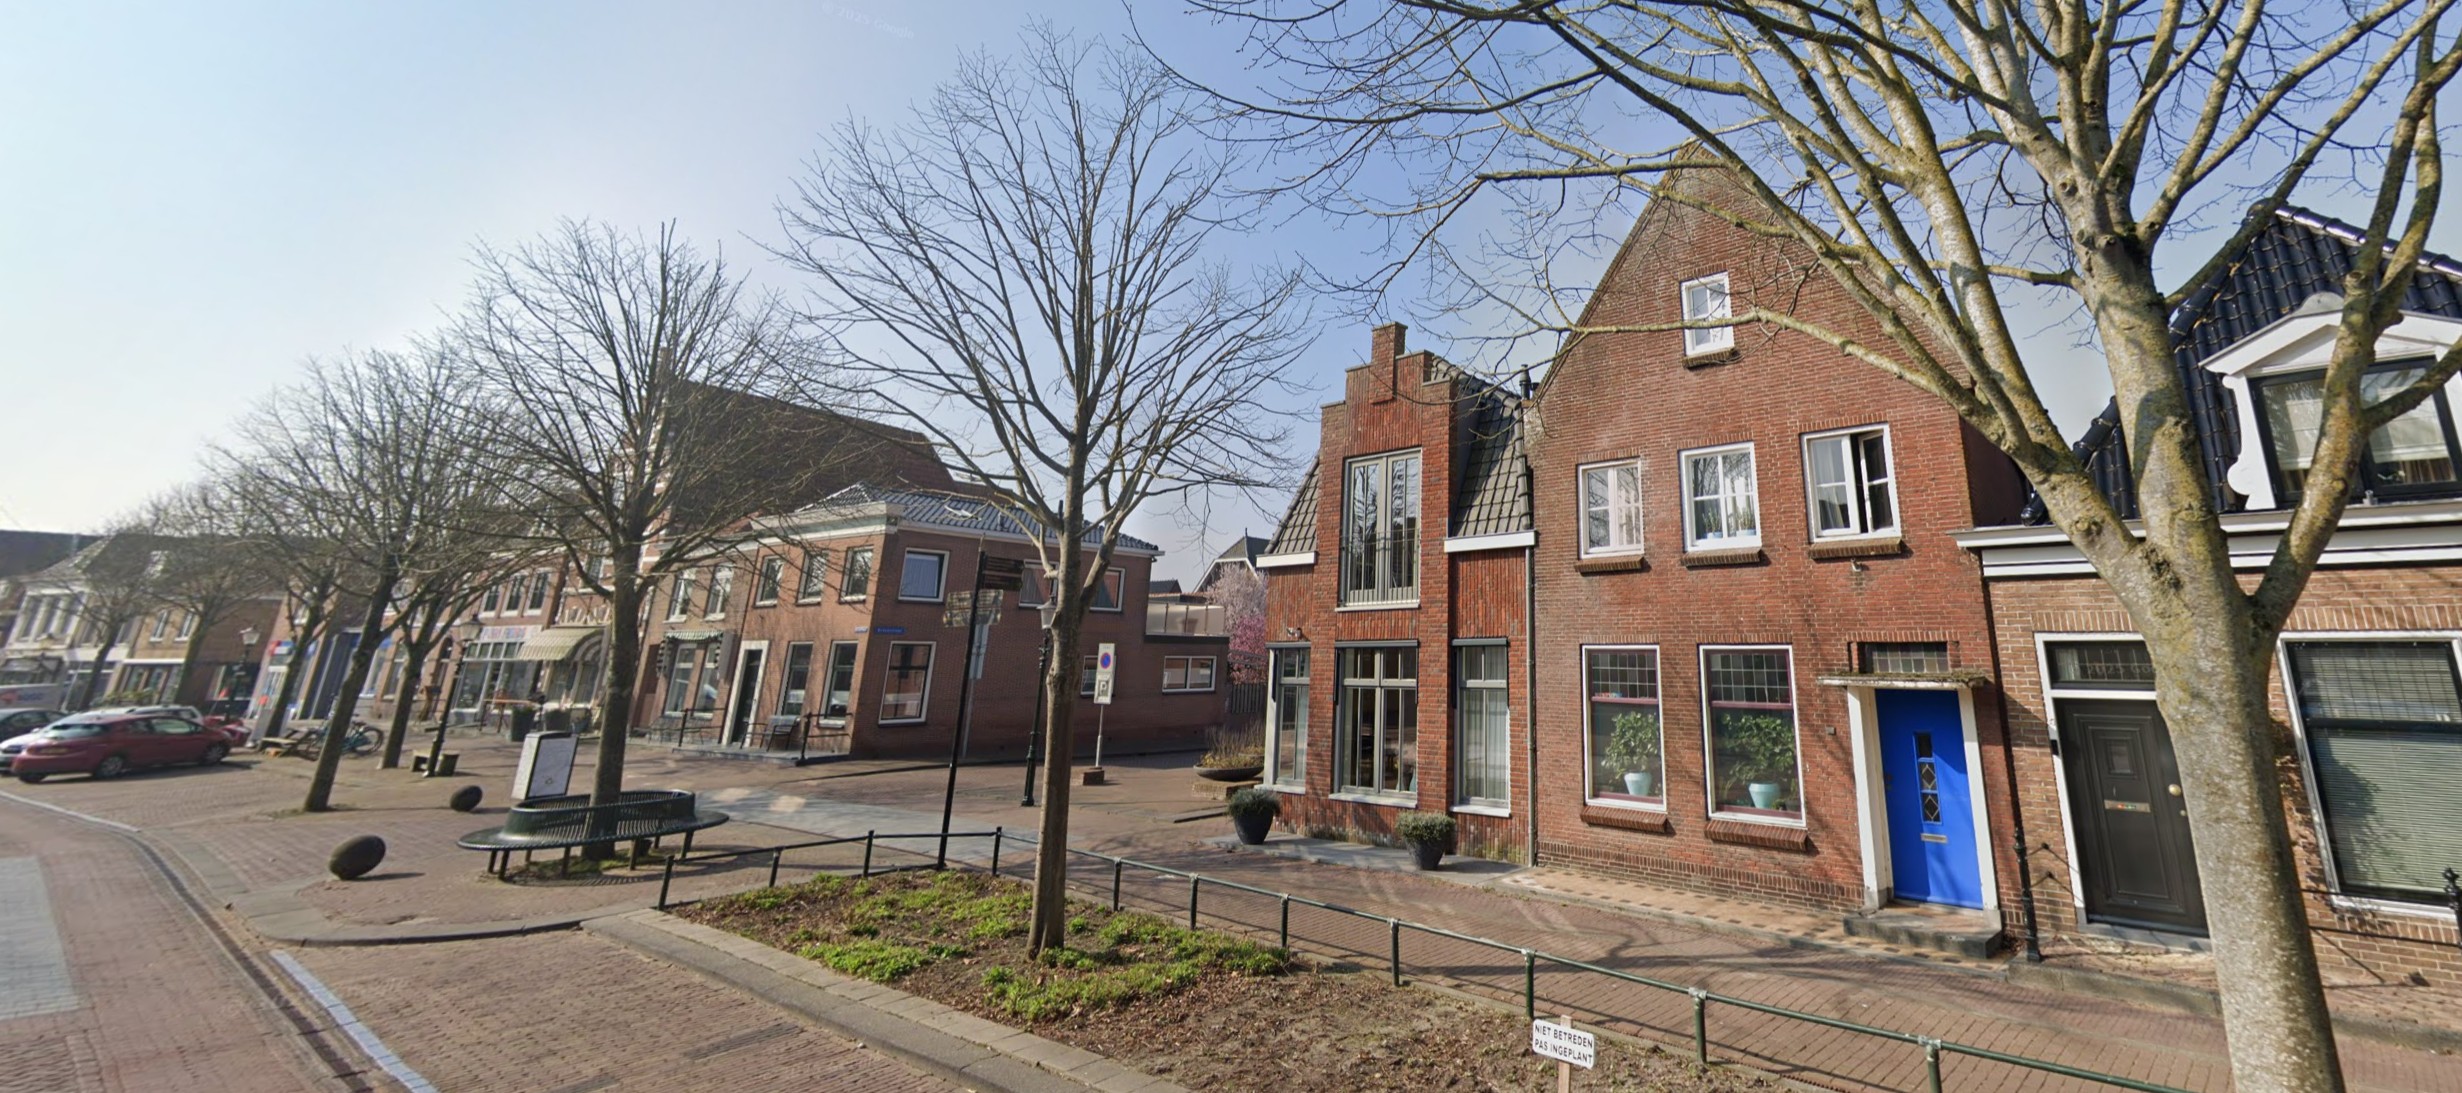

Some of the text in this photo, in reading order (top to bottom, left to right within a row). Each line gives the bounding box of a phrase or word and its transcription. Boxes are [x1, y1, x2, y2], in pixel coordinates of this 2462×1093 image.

[1535, 1024, 1593, 1049] NIET BETREDEN
[1535, 1038, 1593, 1065] PAS INGEPLANT
